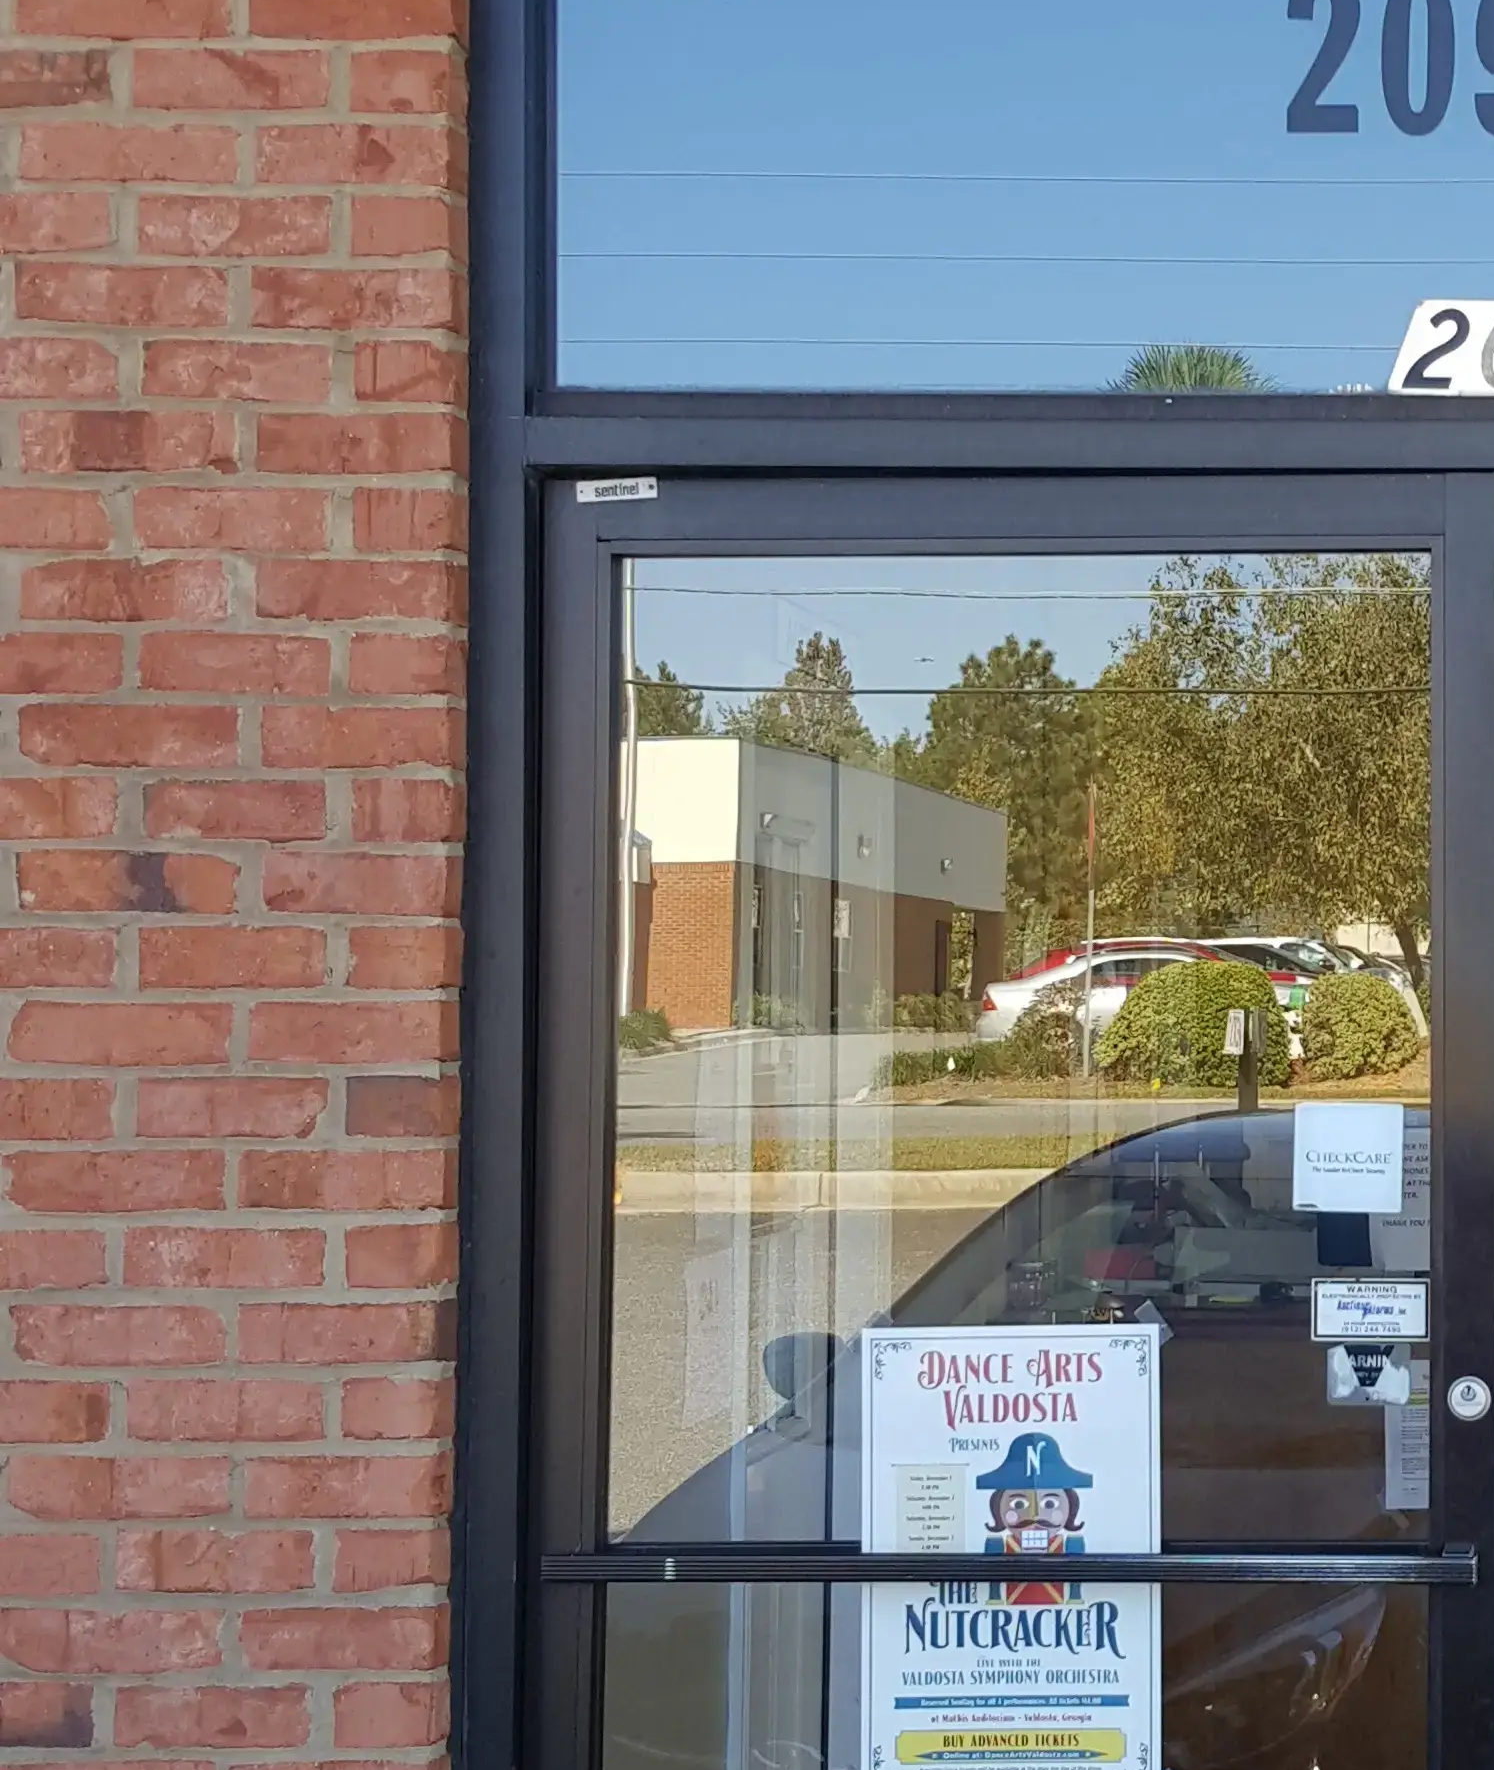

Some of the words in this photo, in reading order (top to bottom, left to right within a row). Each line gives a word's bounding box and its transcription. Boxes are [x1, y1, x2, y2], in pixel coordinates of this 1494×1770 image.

[594, 482, 640, 498] sentinel
[917, 1349, 1014, 1390] DANCE
[1026, 1348, 1103, 1389] ARTS
[943, 1385, 1079, 1431] VALDOSTA
[948, 1436, 1000, 1452] PRESENTS
[1026, 1440, 1048, 1477] N
[904, 1596, 1127, 1660] NUTCRACKER
[902, 1670, 965, 1686] VALDOSTA
[970, 1669, 1041, 1685] SYMPHONY
[1045, 1668, 1120, 1684] ORCHESTRA
[942, 1714, 969, 1723] Mathis
[1061, 1713, 1092, 1724] Georgia
[943, 1735, 965, 1748] BUY
[1035, 1734, 1080, 1747] TICKETS
[942, 1752, 972, 1760] Online
